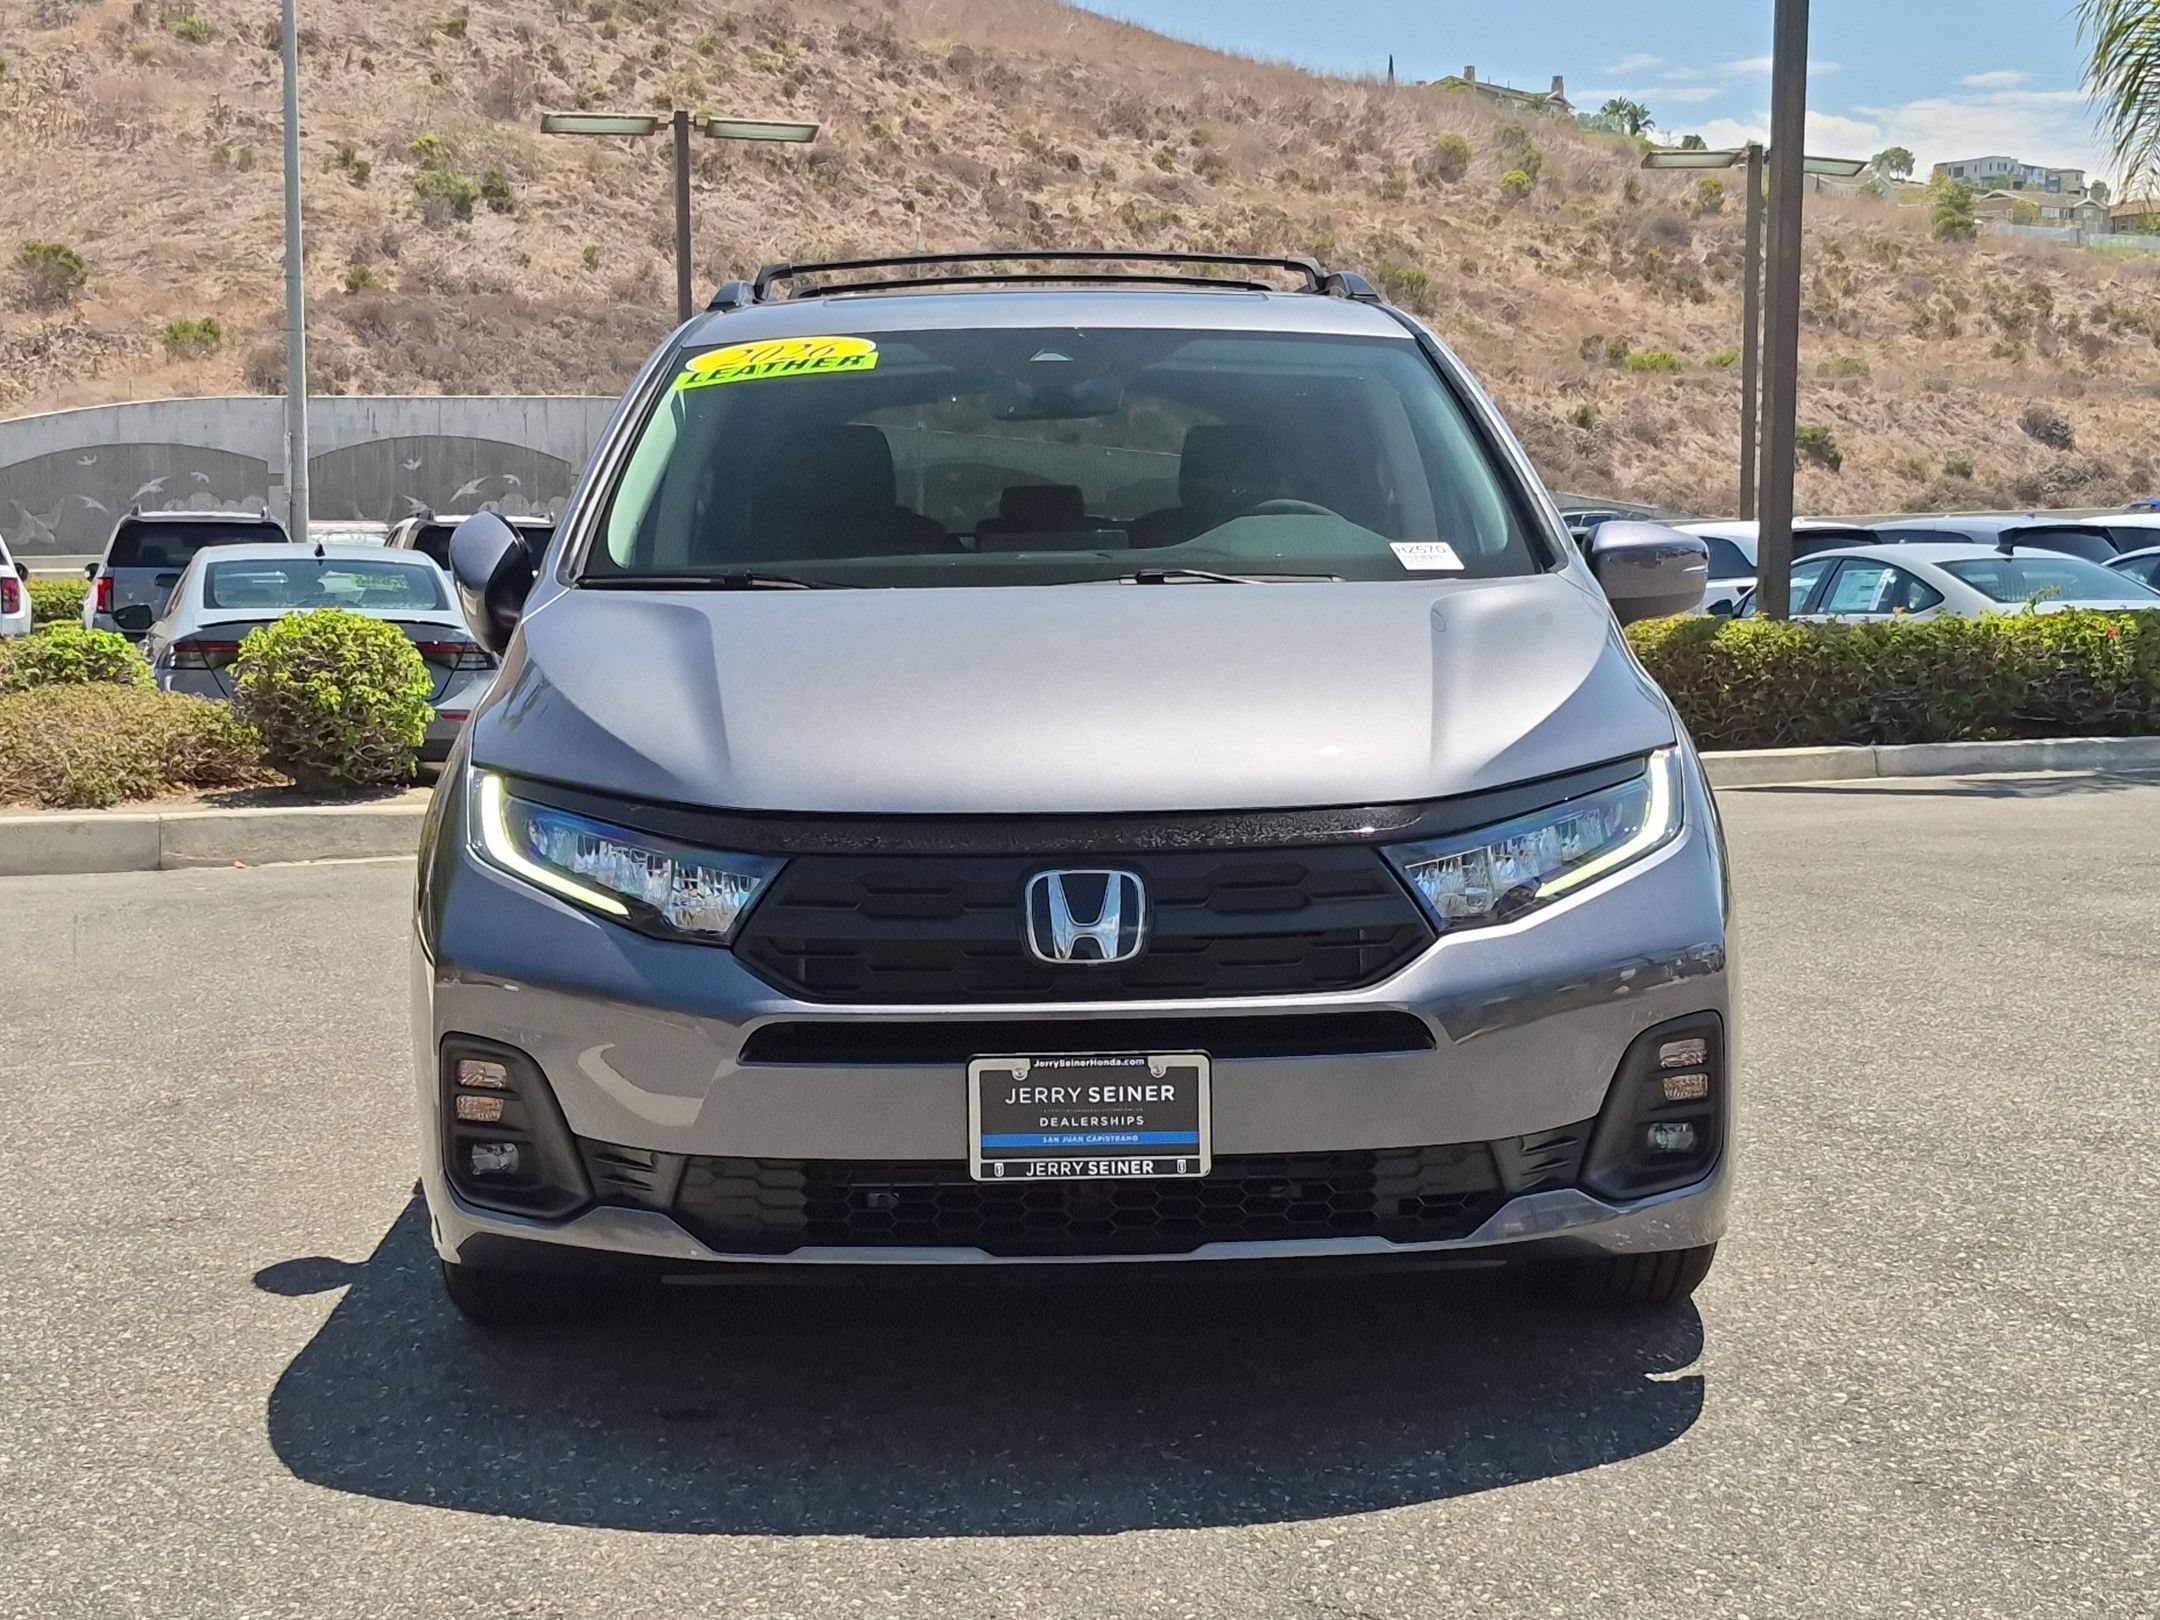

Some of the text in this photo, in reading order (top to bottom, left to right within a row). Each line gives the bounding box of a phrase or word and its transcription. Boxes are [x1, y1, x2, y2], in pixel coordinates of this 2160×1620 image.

[718, 342, 840, 366] 2026
[685, 355, 867, 385] LEATHER
[1033, 1058, 1145, 1070] JerrySeinerHonda.com
[1005, 1085, 1175, 1105] JERRY SEINER
[1039, 1115, 1145, 1128] DEALERSHIPS
[1042, 1136, 1061, 1144] SAN
[1085, 1134, 1139, 1143] CAPISTRANO
[1026, 1160, 1154, 1177] JERRY SEINER
